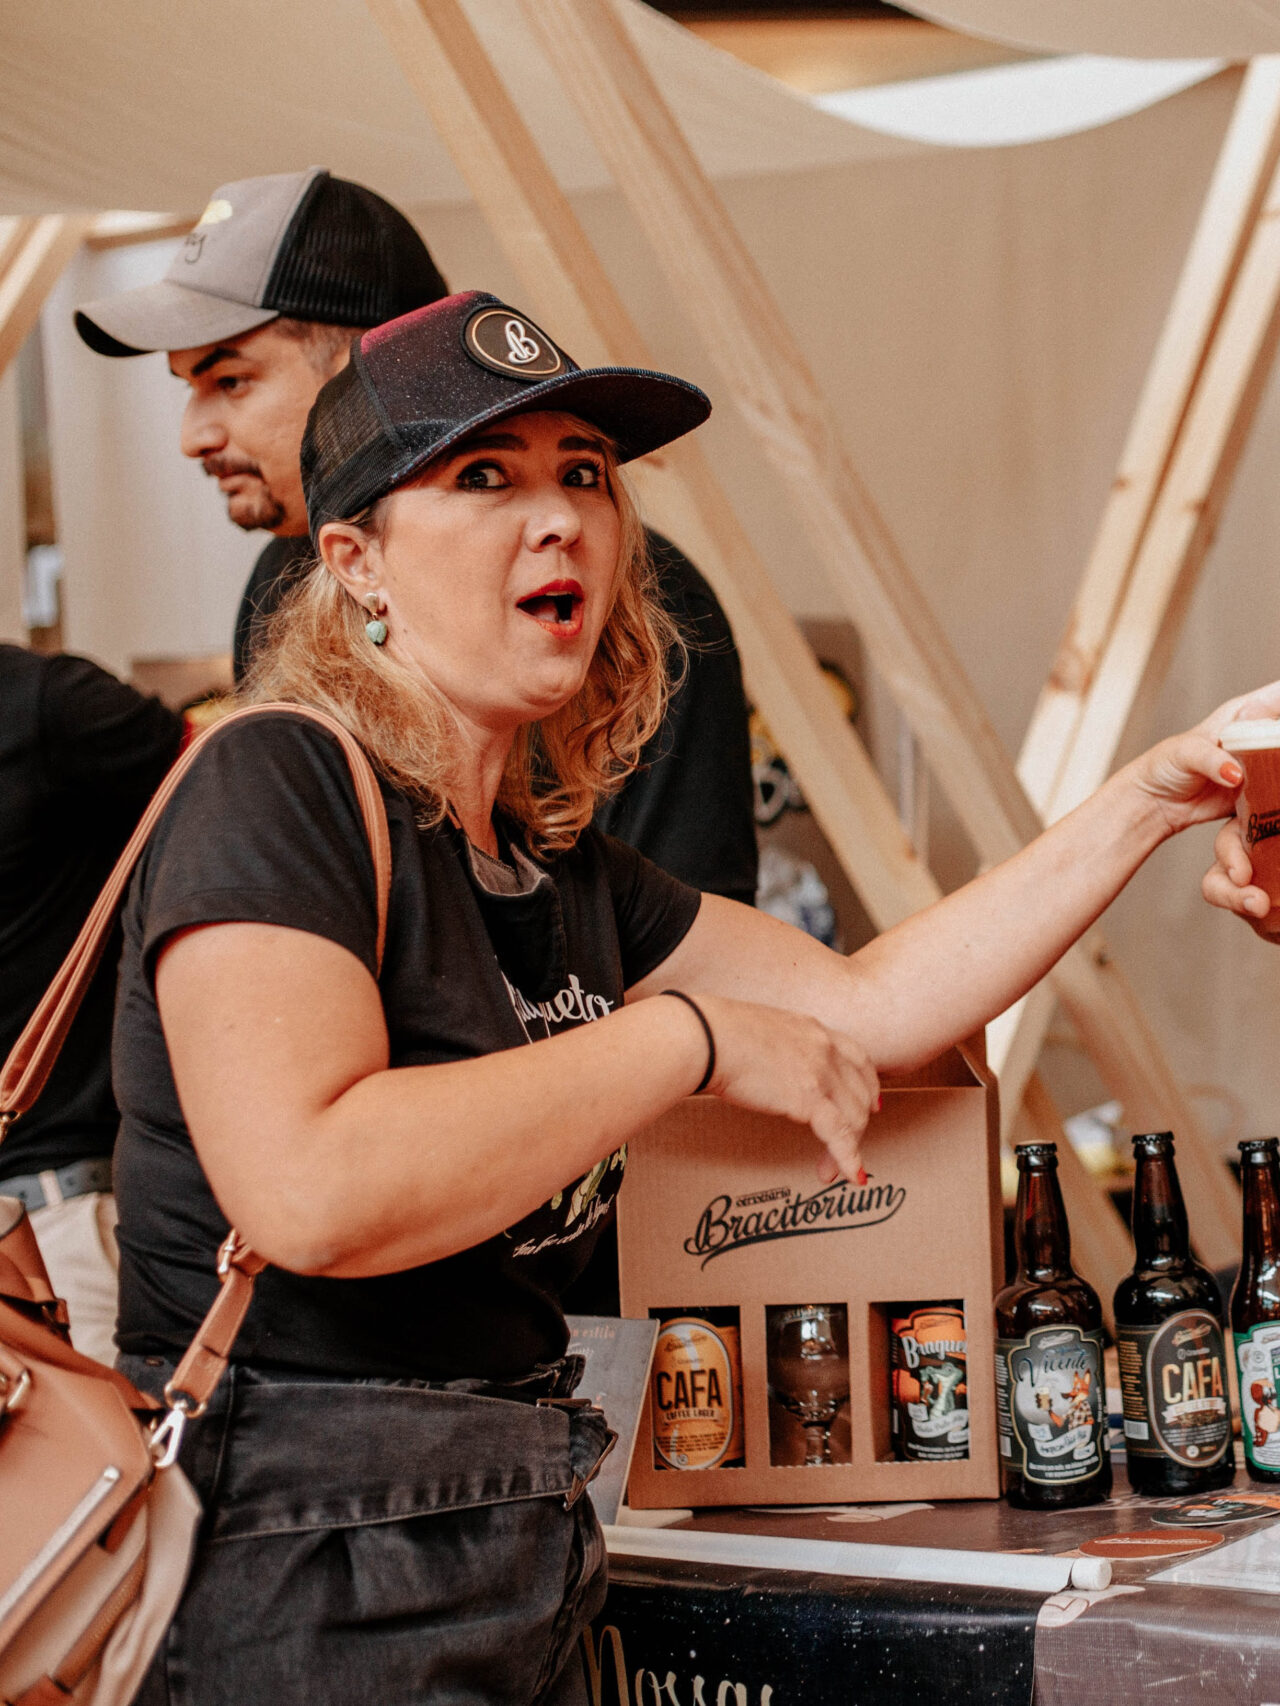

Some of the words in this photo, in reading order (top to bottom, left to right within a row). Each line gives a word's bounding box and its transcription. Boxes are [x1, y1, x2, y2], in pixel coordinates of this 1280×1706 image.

[684, 1176, 906, 1270] Bracitorium
[656, 1368, 722, 1411] CAFA
[1162, 1357, 1224, 1404] CAFA
